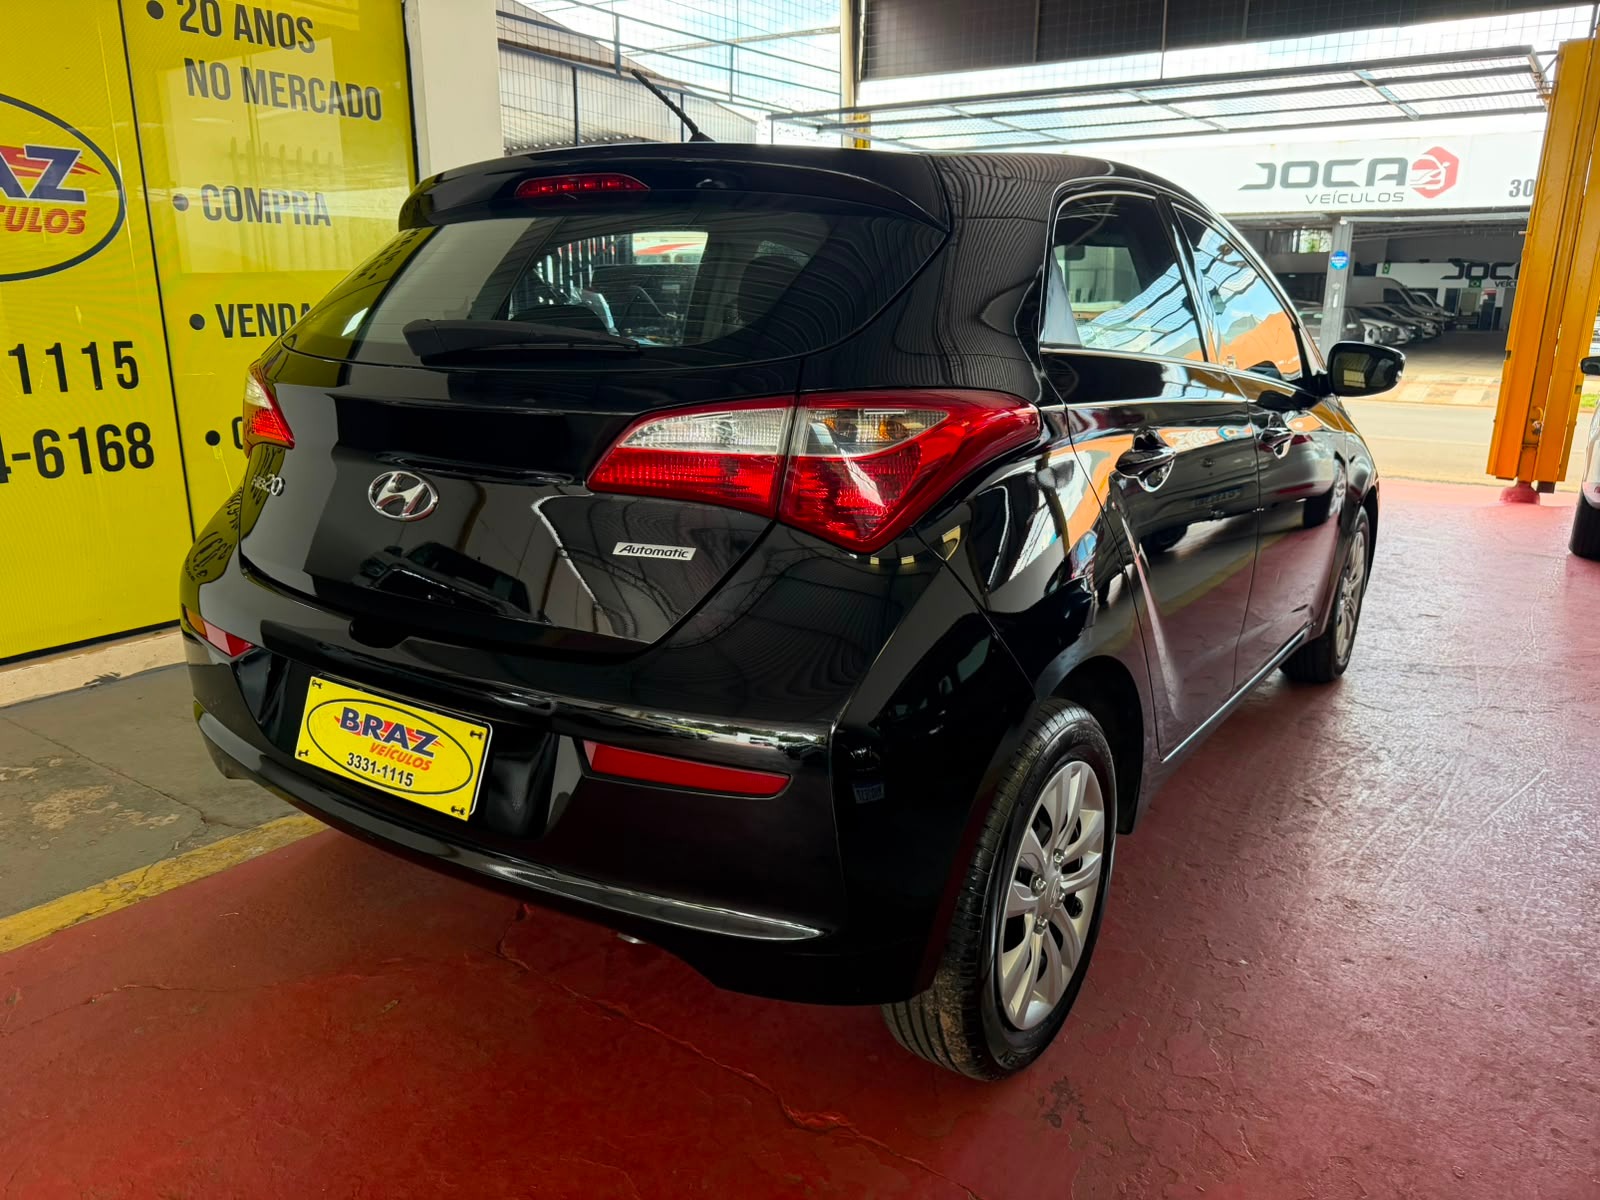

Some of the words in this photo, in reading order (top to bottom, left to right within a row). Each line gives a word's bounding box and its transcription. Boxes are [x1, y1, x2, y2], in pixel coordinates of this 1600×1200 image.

[176, 0, 223, 37] 20
[234, 3, 316, 53] ANOS
[184, 57, 231, 101] NO
[240, 66, 383, 121] MERCADO
[1238, 157, 1409, 191] JOCA
[199, 184, 331, 227] COMPRA
[1305, 190, 1405, 204] VEÍCULOS
[0, 205, 87, 235] ULOS
[8, 341, 140, 395] 1115
[619, 544, 689, 558] Automatic
[339, 706, 440, 759] BRAZ
[346, 752, 414, 788] 3331-1115
[369, 741, 432, 772] VEÍCULOS
